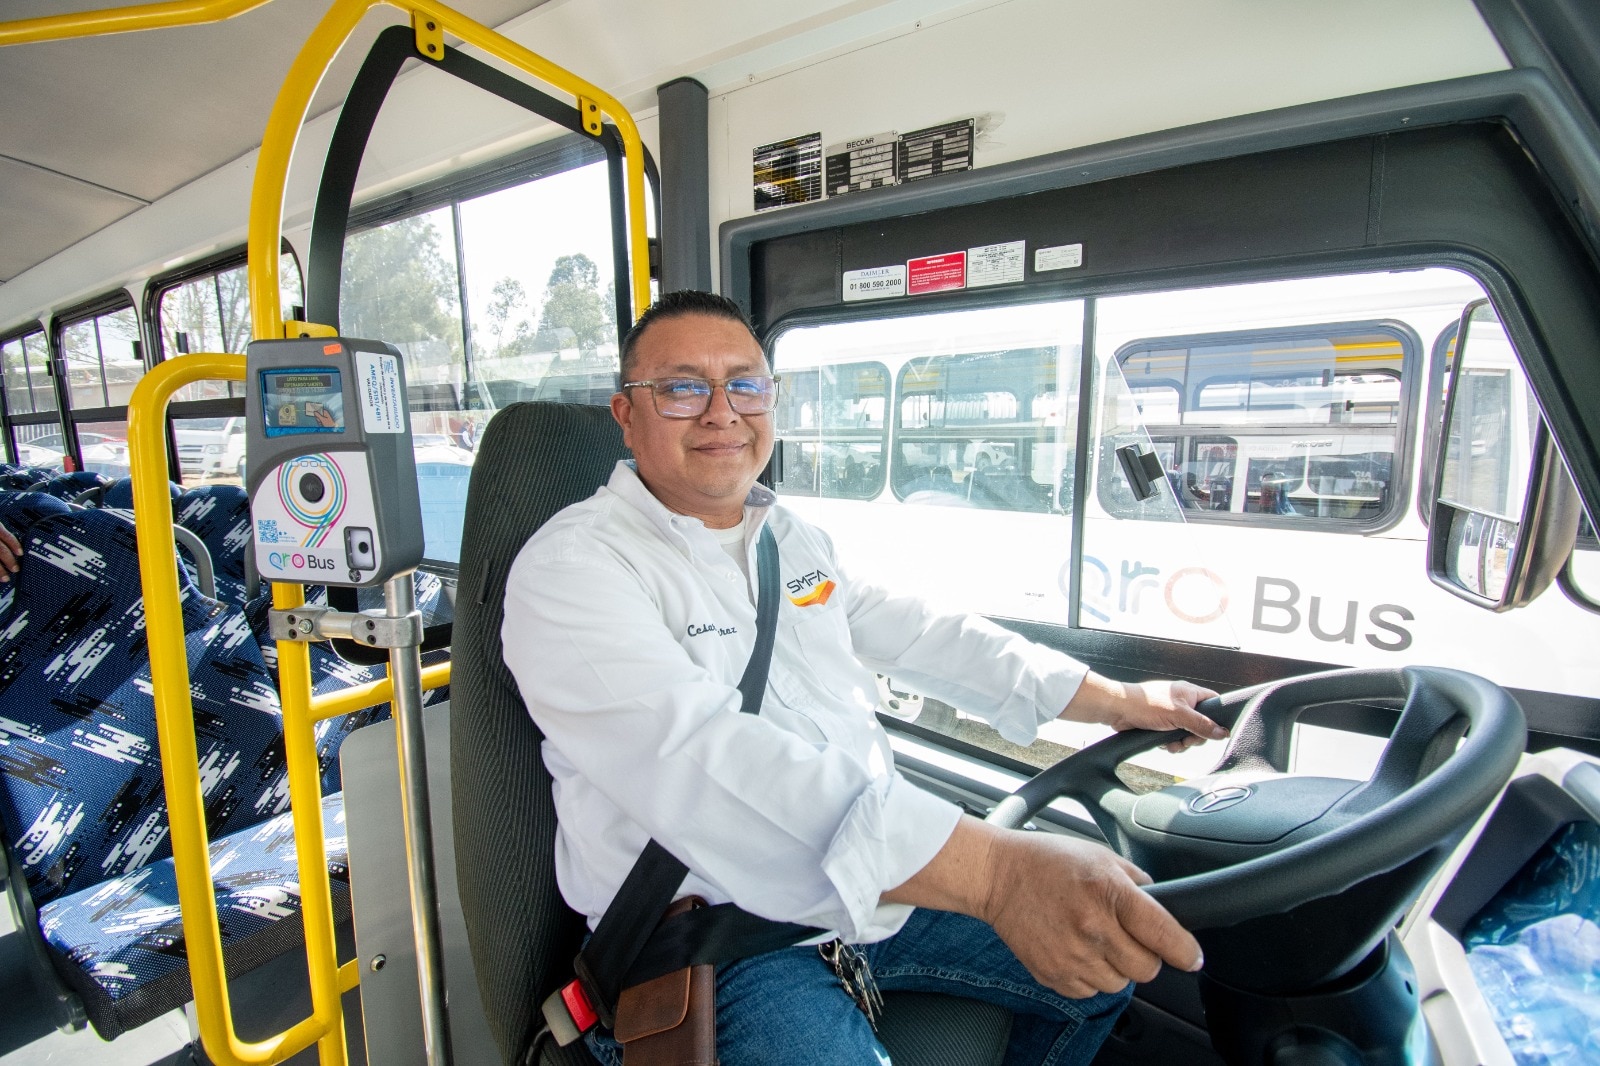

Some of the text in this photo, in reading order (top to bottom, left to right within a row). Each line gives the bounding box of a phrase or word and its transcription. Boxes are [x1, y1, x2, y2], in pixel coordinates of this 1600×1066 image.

[846, 137, 875, 150] BECCAR
[886, 278, 902, 286] 2000
[308, 555, 335, 570] Bus
[786, 570, 828, 594] SMFA
[1252, 575, 1416, 652] Bus
